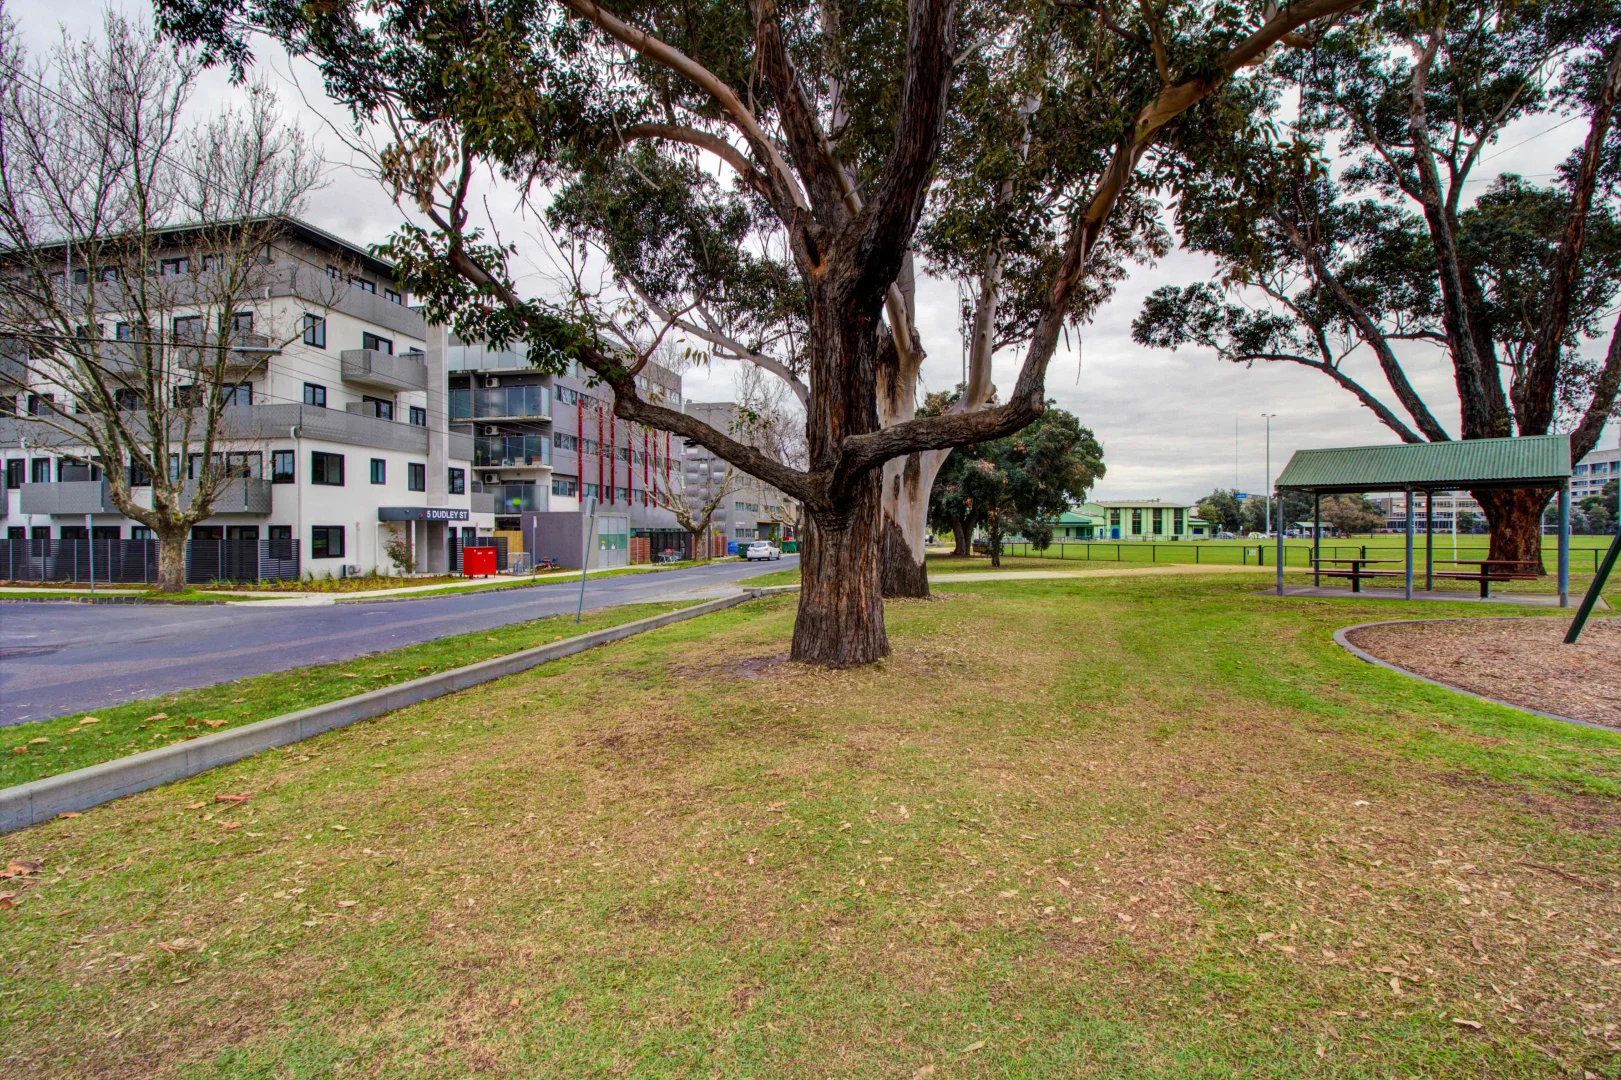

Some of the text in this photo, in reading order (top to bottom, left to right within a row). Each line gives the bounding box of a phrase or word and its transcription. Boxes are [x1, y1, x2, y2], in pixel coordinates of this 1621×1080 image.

[427, 510, 467, 519] 5 DUDLEY ST
